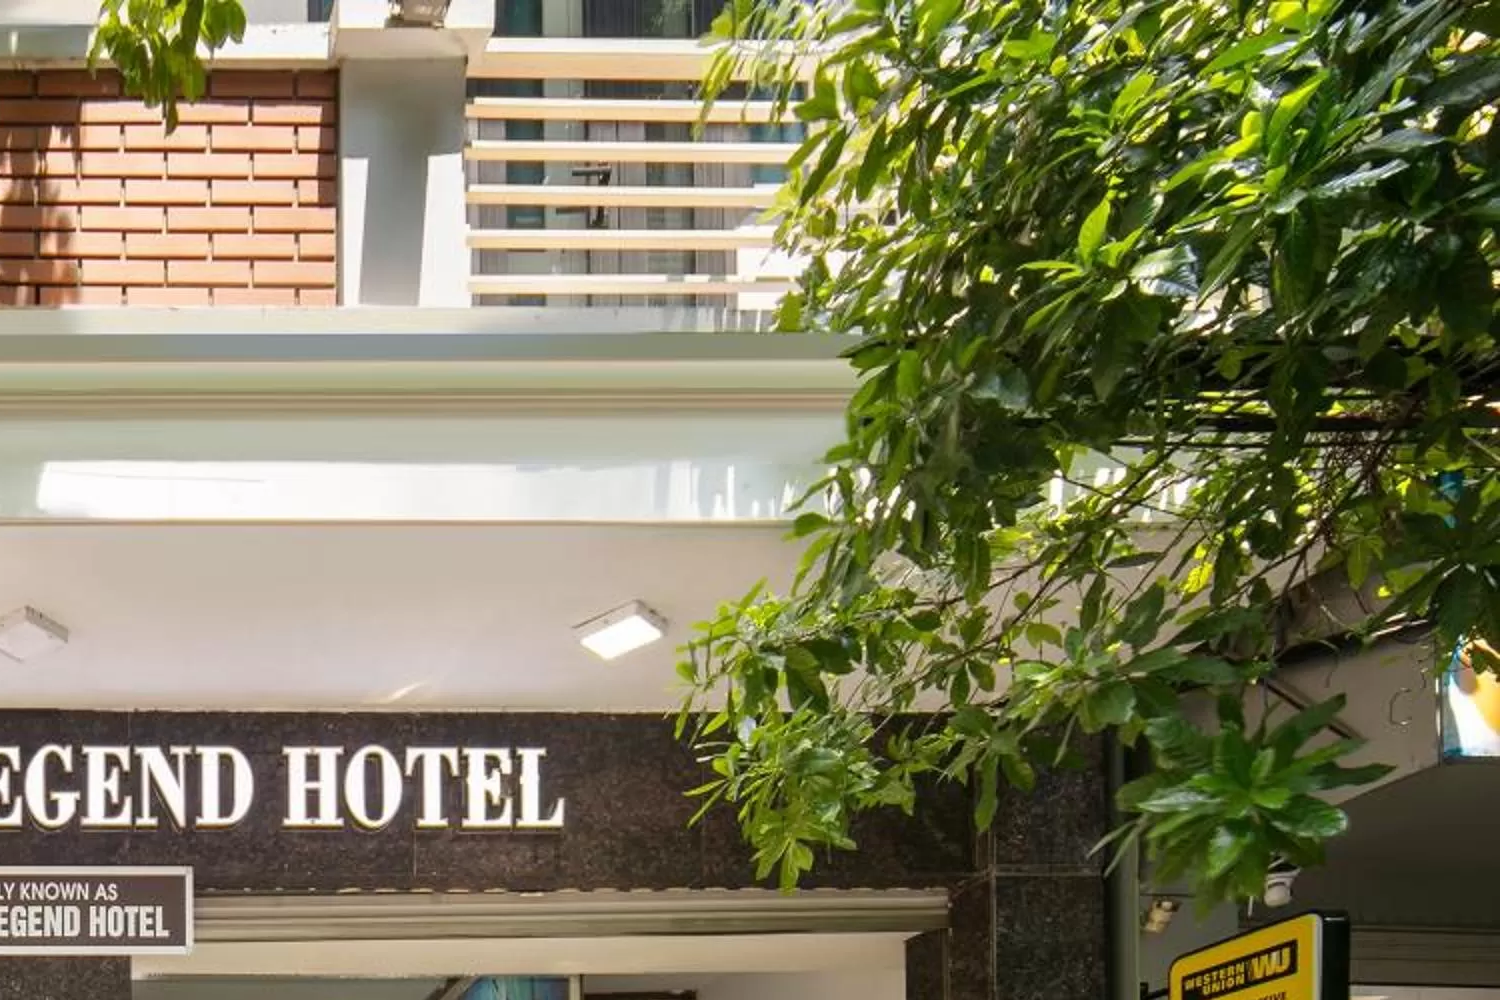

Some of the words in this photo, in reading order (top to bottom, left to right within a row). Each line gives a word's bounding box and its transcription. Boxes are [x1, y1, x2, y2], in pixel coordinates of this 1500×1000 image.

[282, 744, 565, 830] HOTEL
[20, 881, 89, 900] KNOWN
[94, 882, 119, 901] AS
[89, 905, 170, 938] HOTEL
[1184, 961, 1245, 991] WESTERN
[1249, 946, 1291, 980] WU
[1202, 975, 1245, 996] UNION
